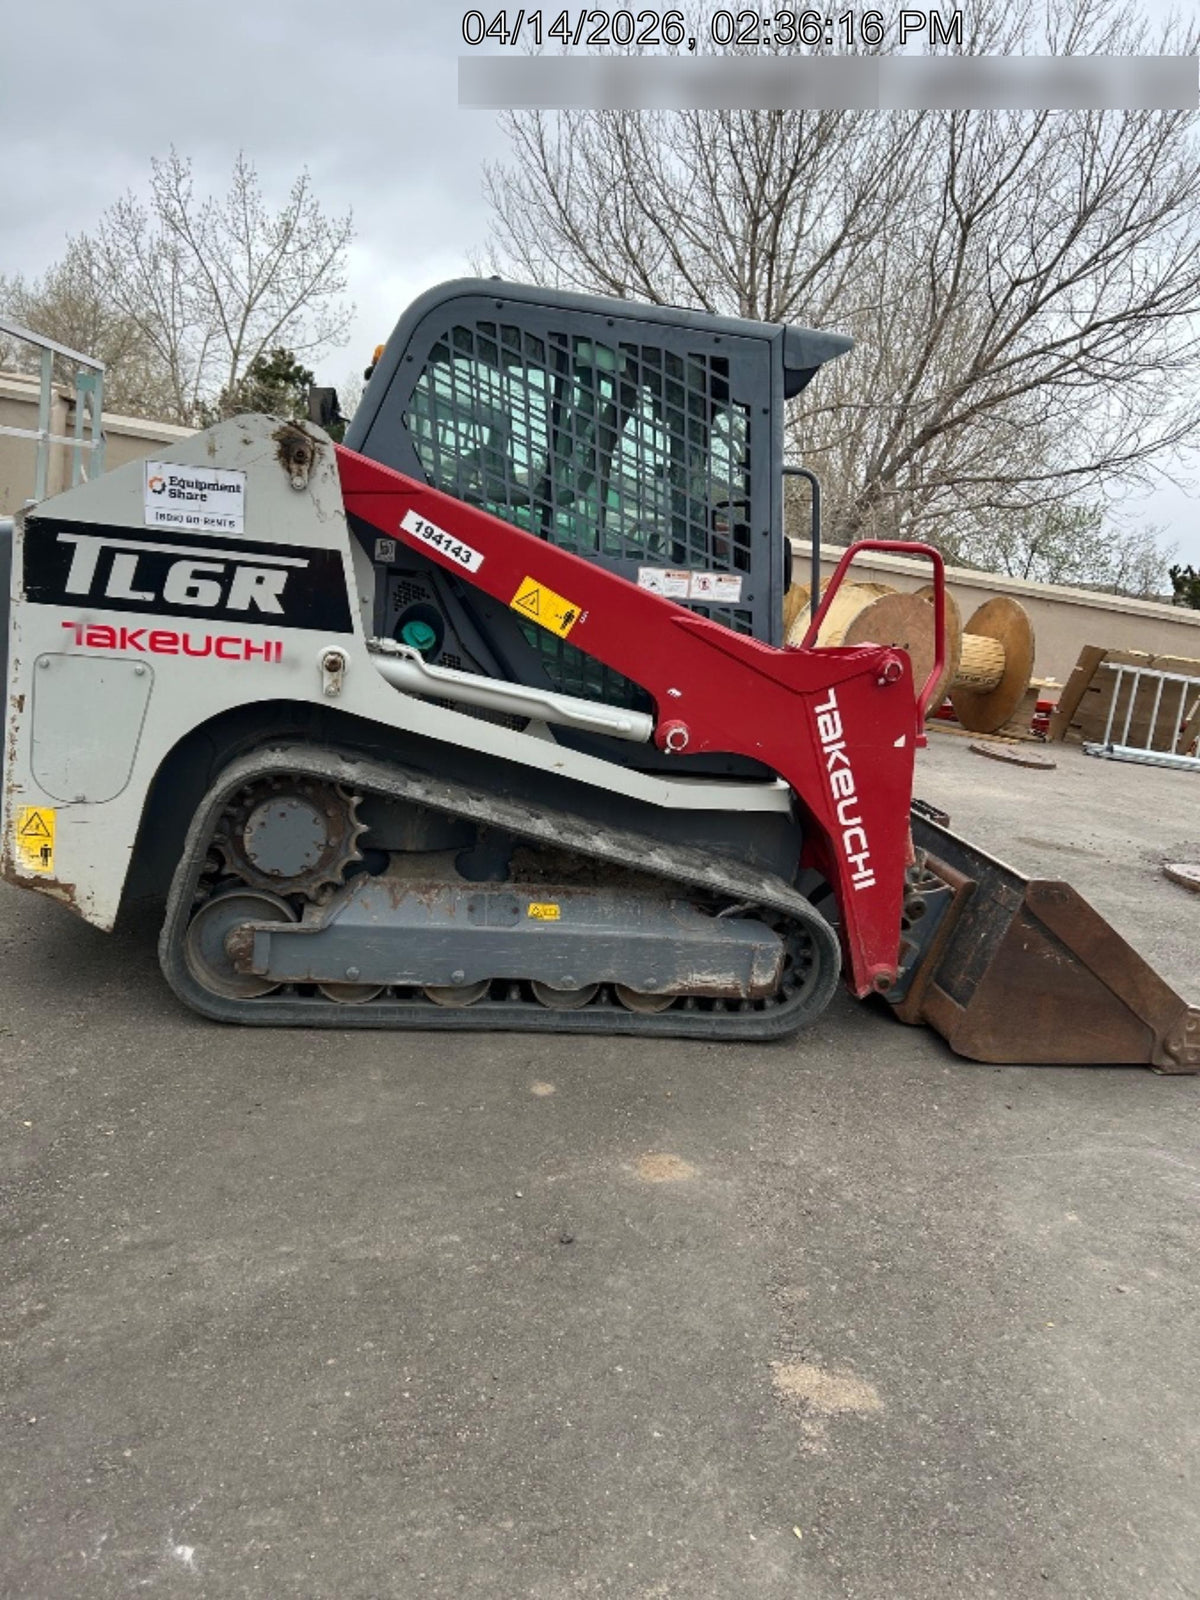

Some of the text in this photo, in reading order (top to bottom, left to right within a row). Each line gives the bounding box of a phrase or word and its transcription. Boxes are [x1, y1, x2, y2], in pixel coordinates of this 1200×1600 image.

[168, 476, 241, 493] Equipment
[168, 488, 207, 502] Share
[414, 520, 472, 564] 194143
[57, 532, 309, 615] TL6R
